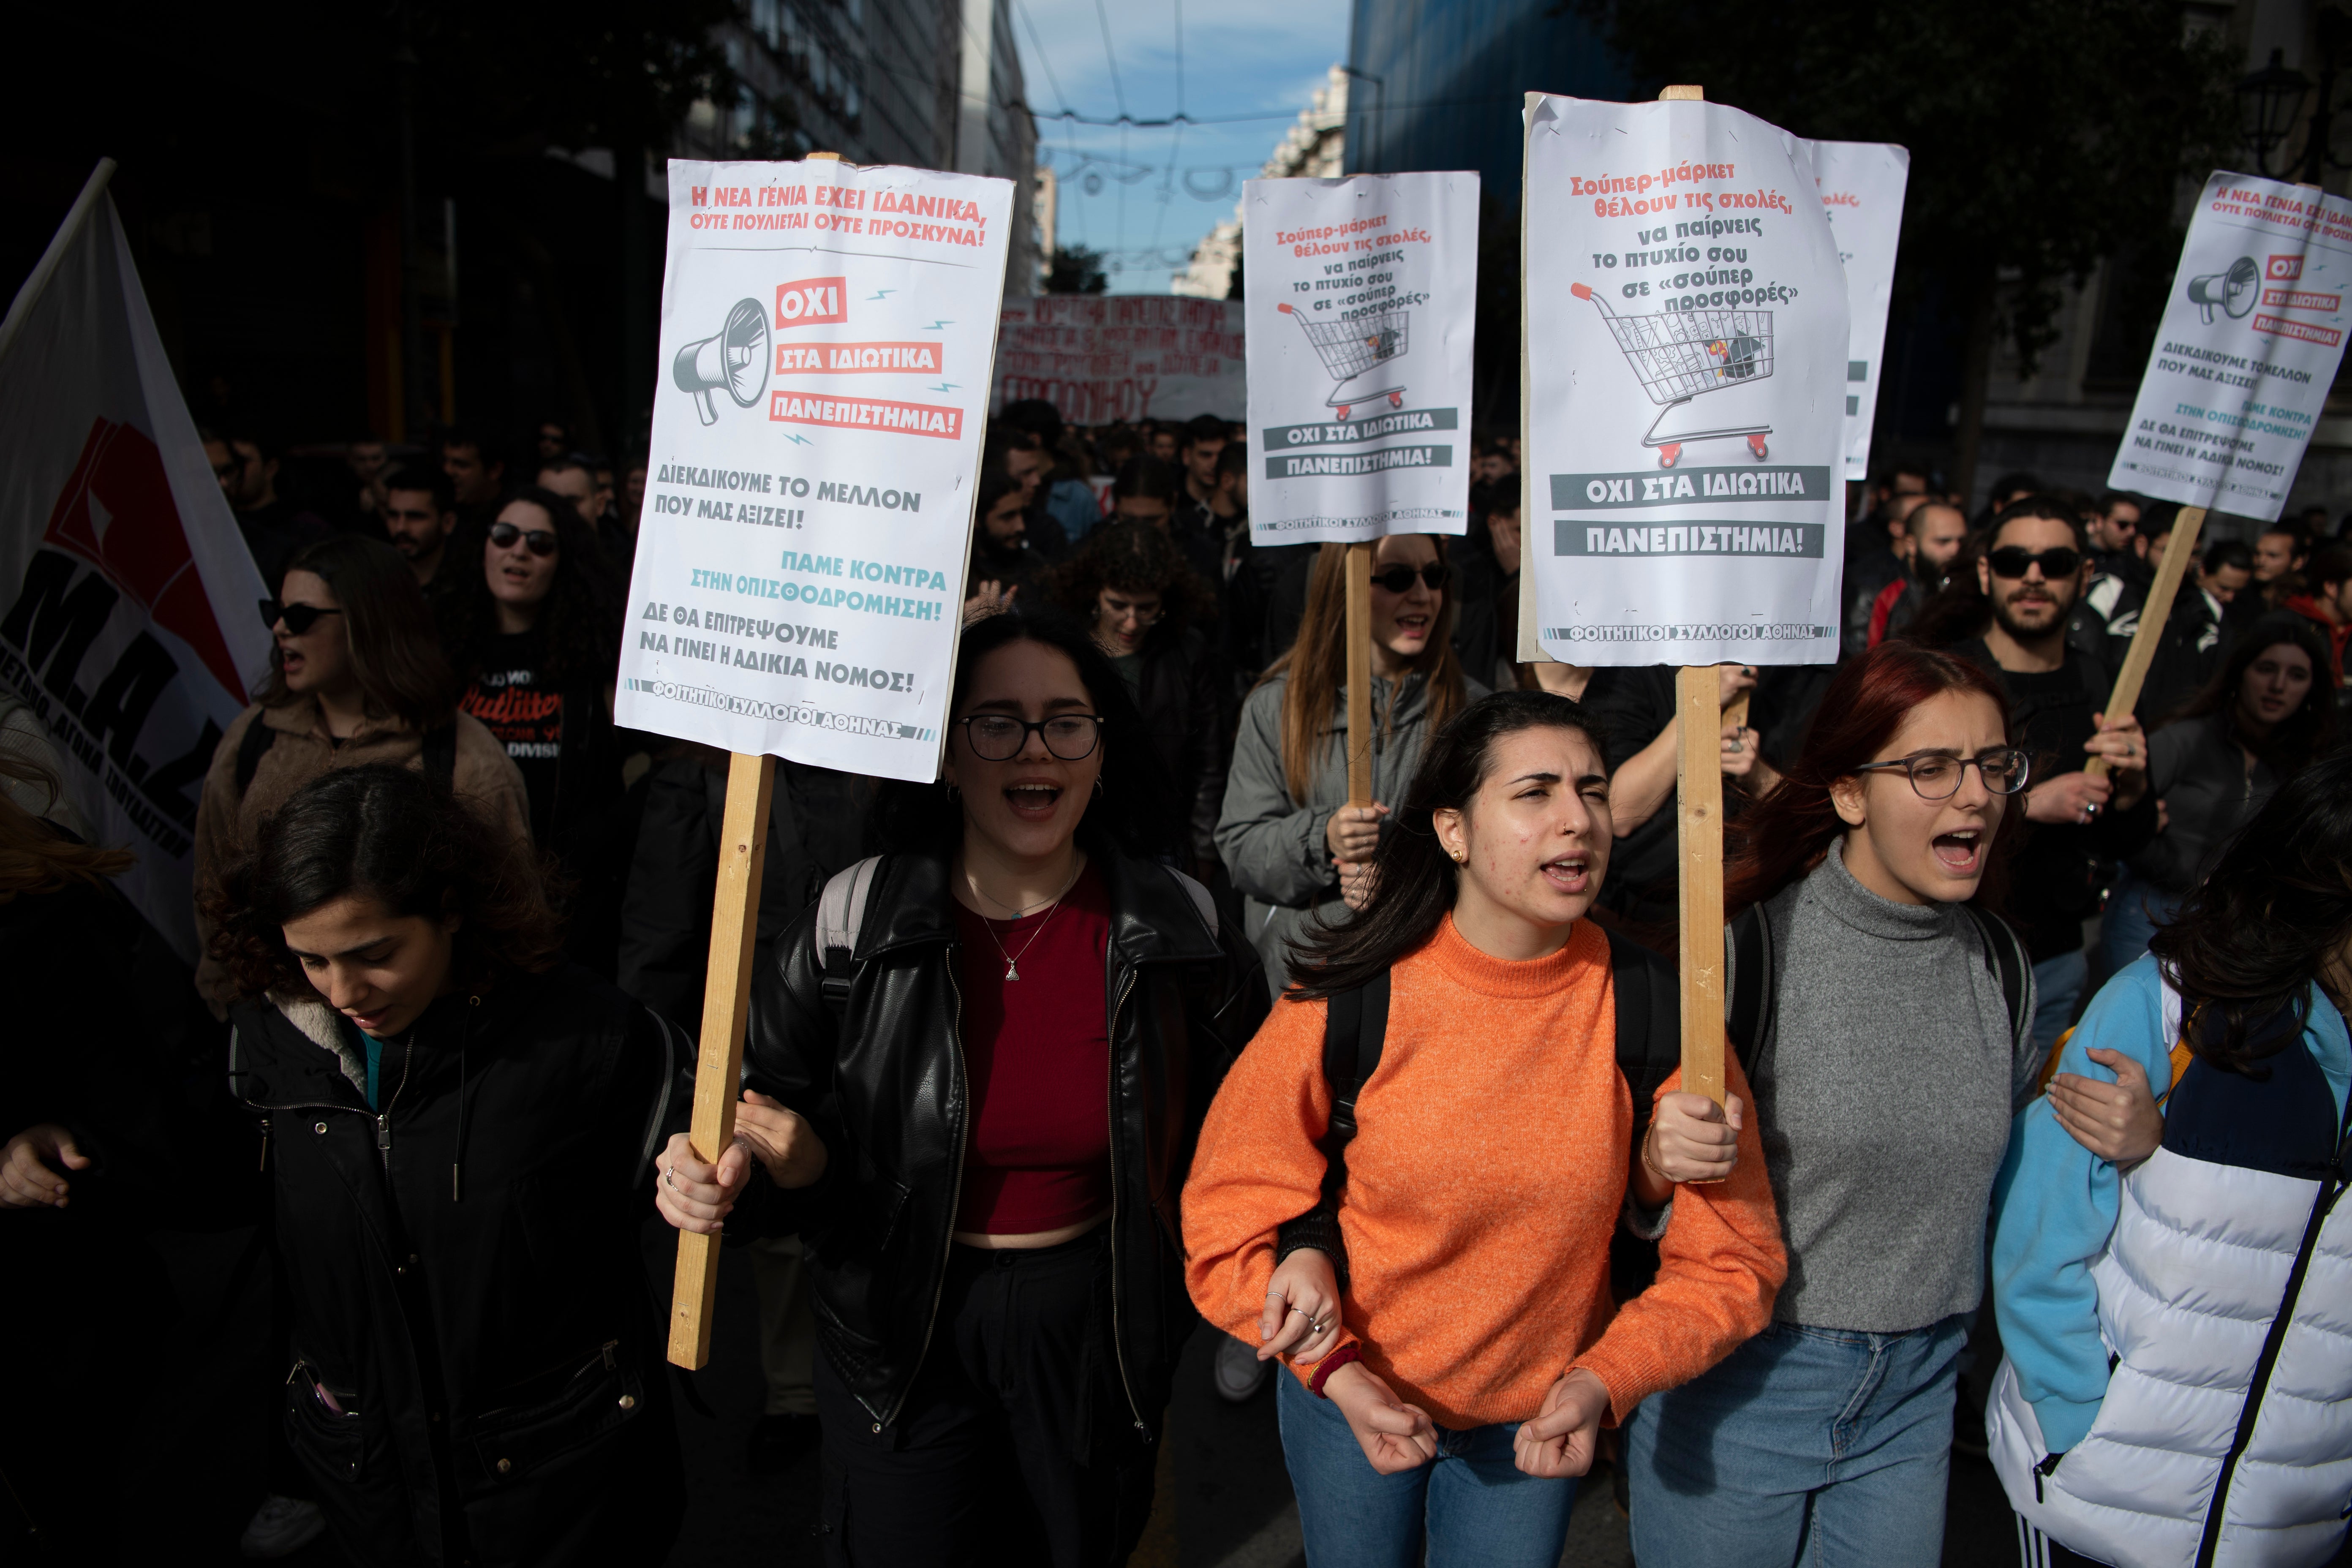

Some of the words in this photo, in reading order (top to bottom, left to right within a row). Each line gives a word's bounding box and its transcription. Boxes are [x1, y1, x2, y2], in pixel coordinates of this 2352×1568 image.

[1570, 161, 1734, 196] Σούπερ-μάρκετ
[692, 187, 707, 206] Η
[714, 187, 751, 207] ΝΕΑ
[760, 185, 807, 206] ΓΕΝΙΑ
[815, 186, 864, 210] ΕΧΕΙ
[874, 192, 987, 227] ΙΔΑΝΙΚΑ,
[1595, 195, 1677, 218] θέλουν
[1685, 193, 1712, 212] τις
[1719, 189, 1792, 215] σχολές,
[2212, 202, 2241, 215] ΟΥΤΕ
[2244, 208, 2300, 227] ΠΟΥΛΙΕΤΑΙ
[2216, 187, 2229, 199] Η
[2232, 190, 2260, 204] ΝΕΑ
[2265, 195, 2303, 214] ΓΕΝΙΑ
[690, 214, 728, 229] ΟΥΤΕ
[733, 212, 808, 230] ΠΟΥΛΙΕΤΑΙ
[814, 214, 862, 233] ΟΥΤΕ
[869, 220, 985, 247] ΠΡΟΣΚΥΝΑ!
[1277, 215, 1387, 245] Σούπερ-μάρκετ
[1294, 240, 1349, 258] θέλουν
[1354, 239, 1372, 251] τις
[1376, 229, 1431, 247] σχολές,
[1638, 230, 1667, 246] να
[1676, 217, 1762, 240] παίρνεις
[1324, 264, 1342, 275] να
[1348, 249, 1404, 272] παίρνεις
[1592, 252, 1617, 269] το
[1625, 242, 1699, 268] πτυχίο
[1707, 248, 1747, 263] σου
[2271, 259, 2301, 277] ΟΧΙ
[1293, 280, 1310, 292] το
[1316, 275, 1363, 291] πτυχίο
[1368, 272, 1393, 285] σου
[1622, 283, 1650, 298] σε
[1659, 265, 1753, 291] «σούπερ
[781, 287, 838, 319] ΟΧΙ
[1313, 299, 1331, 311] σε
[1338, 285, 1396, 306] «σούπερ
[1341, 292, 1430, 321] προσφορές»
[1665, 282, 1799, 313] προσφορές»
[781, 349, 819, 369] ΣΤΑ
[830, 348, 934, 369] ΙΔΙΩΤΙΚΑ
[2157, 358, 2187, 374] ΠΟΥ
[2188, 365, 2214, 379] ΜΑΣ
[2162, 342, 2248, 369] ΔΙΕΚΔΙΚΟΥΜΕ
[774, 397, 955, 433] ΠΑΝΕΠΙΣΤΗΜΙΑ!
[2176, 403, 2205, 419] ΣΤΗΝ
[2269, 406, 2311, 425] ΚΟΝΤΡΑ
[1288, 427, 1319, 444] ΟΧΙ
[1326, 425, 1358, 441] ΣΤΑ
[1364, 413, 1433, 437] ΙΔΙΩΤΙΚΑ
[2139, 419, 2156, 431] ΔΕ
[2159, 423, 2176, 436] ΘΑ
[1288, 448, 1432, 475] ΠΑΝΕΠΙΣΤΗΜΙΑ!
[2135, 436, 2152, 449] ΝΑ
[2154, 439, 2185, 457] ΓΙΝΕΙ
[2186, 446, 2197, 458] Η
[2236, 457, 2284, 476] ΝΟΜΟΣ!
[658, 465, 772, 494] ΔΙΕΚΔΙΚΟΥΜΕ
[779, 476, 809, 498] ΤΟ
[817, 482, 921, 513] ΜΕΛΛΟΝ
[1586, 480, 1633, 503] ΟΧΙ
[1642, 478, 1695, 500] ΣΤΑ
[1704, 473, 1804, 496] ΙΔΙΩΤΙΚΑ
[655, 495, 694, 514] ΠΟΥ
[698, 500, 733, 520] ΜΑΣ
[738, 506, 804, 530] ΑΞΙΖΕΙ!
[1276, 517, 1342, 531] ΦΟΙΤΗΤΙΚΟΙ
[1345, 511, 1394, 528] ΣΥΛΛΟΓΟΙ
[1395, 509, 1443, 519] ΑΘΗΝΑΣ
[1587, 527, 1802, 553] ΠΑΝΕΠΙΣΤΗΜΙΑ!
[781, 551, 843, 574] ΠΑΜΕ
[850, 560, 946, 591] ΚΟΝΤΡΑ
[691, 569, 732, 592] ΣΤΗΝ
[736, 575, 943, 622] ΟΠΙΣΘΟΔΡΟΜΗΣΗ!
[642, 602, 668, 621] ΔΕ
[674, 607, 699, 627] ΘΑ
[705, 611, 838, 650] ΕΠΙΤΡΕΨΟΥΜΕ
[1570, 625, 1670, 642] ΦΟΙΤΗΤΙΚΟΙ
[1674, 624, 1756, 641] ΣΥΛΛΟΓΟΙ
[1760, 624, 1815, 640] ΑΘΗΝΑΣ
[640, 632, 668, 653] ΝΑ
[675, 637, 715, 661] ΓΙΝΕΙ
[720, 646, 730, 664] Η
[734, 649, 808, 677] ΑΔΙΚΙΑ
[815, 662, 915, 693] ΝΟΜΟΣ!
[653, 681, 730, 710] ΦΟΙΤΗΤΙΚΟΙ
[732, 697, 817, 724] ΣΥΛΛΟΓΟΙ
[820, 713, 902, 738] ΑΘΗΝΑΣ
[506, 741, 561, 759] DIVISI
